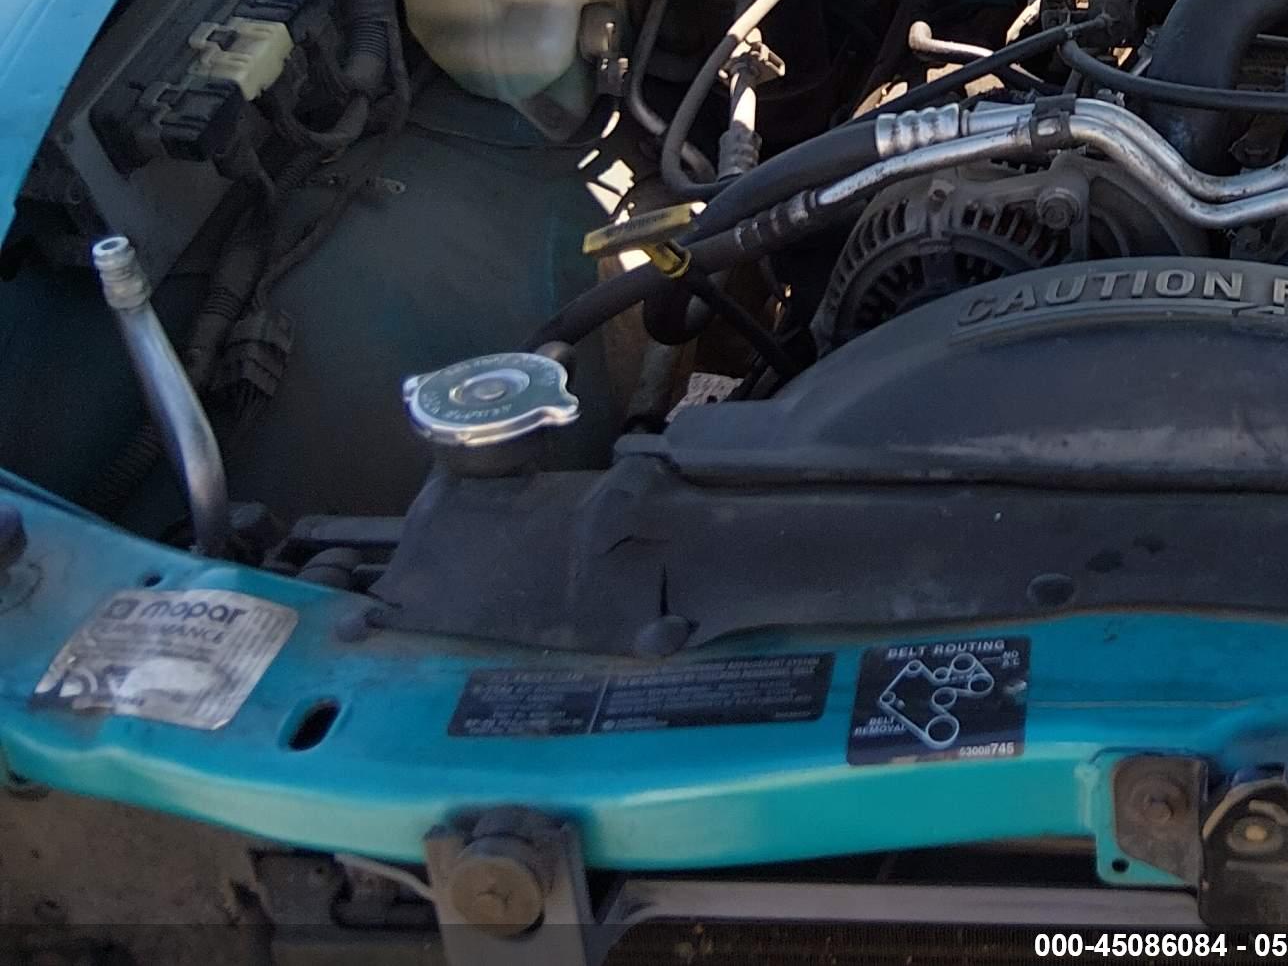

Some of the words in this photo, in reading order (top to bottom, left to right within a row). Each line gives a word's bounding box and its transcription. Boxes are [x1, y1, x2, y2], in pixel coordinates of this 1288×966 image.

[957, 268, 1244, 327] CAUTION
[141, 599, 249, 625] mopar
[887, 645, 927, 659] BELT
[933, 640, 1005, 656] ROUTING
